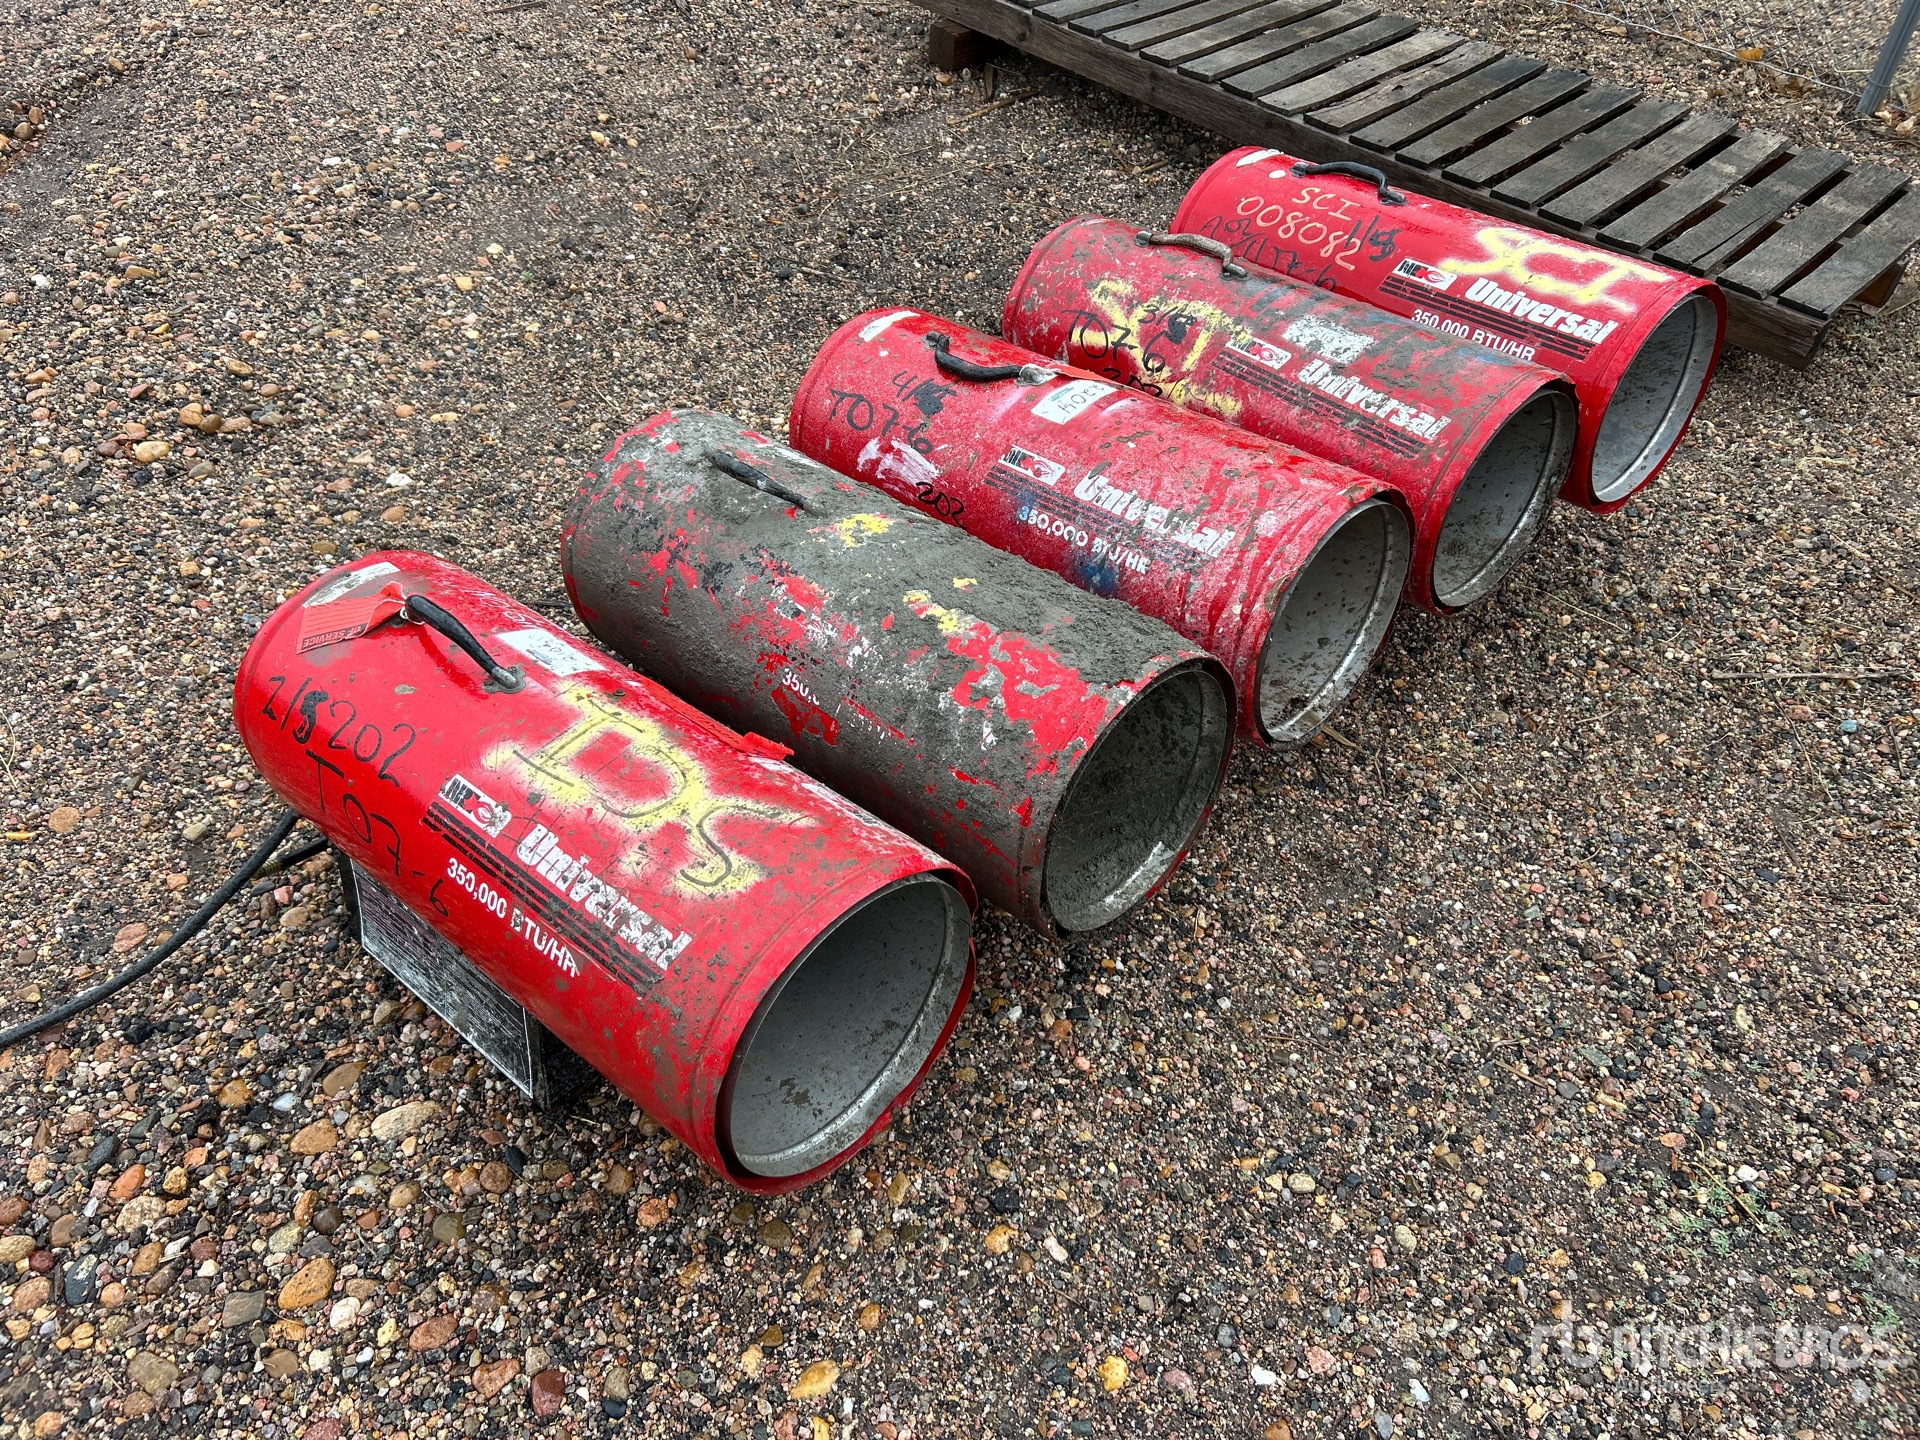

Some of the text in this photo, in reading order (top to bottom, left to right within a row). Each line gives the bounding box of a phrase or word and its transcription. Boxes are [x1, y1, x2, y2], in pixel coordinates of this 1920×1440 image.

[1236, 195, 1363, 271] 008082
[1291, 186, 1361, 221] SCI
[1436, 226, 1671, 314] SCI
[1464, 277, 1619, 345] Universal
[1471, 328, 1536, 361] BTU/HR
[1298, 358, 1452, 441] Universal
[915, 481, 967, 530] 202
[1073, 471, 1236, 558] Universal
[302, 628, 345, 648] SERVICE
[327, 699, 416, 787] 202
[447, 857, 508, 919] 350,000
[516, 823, 694, 971] Universal
